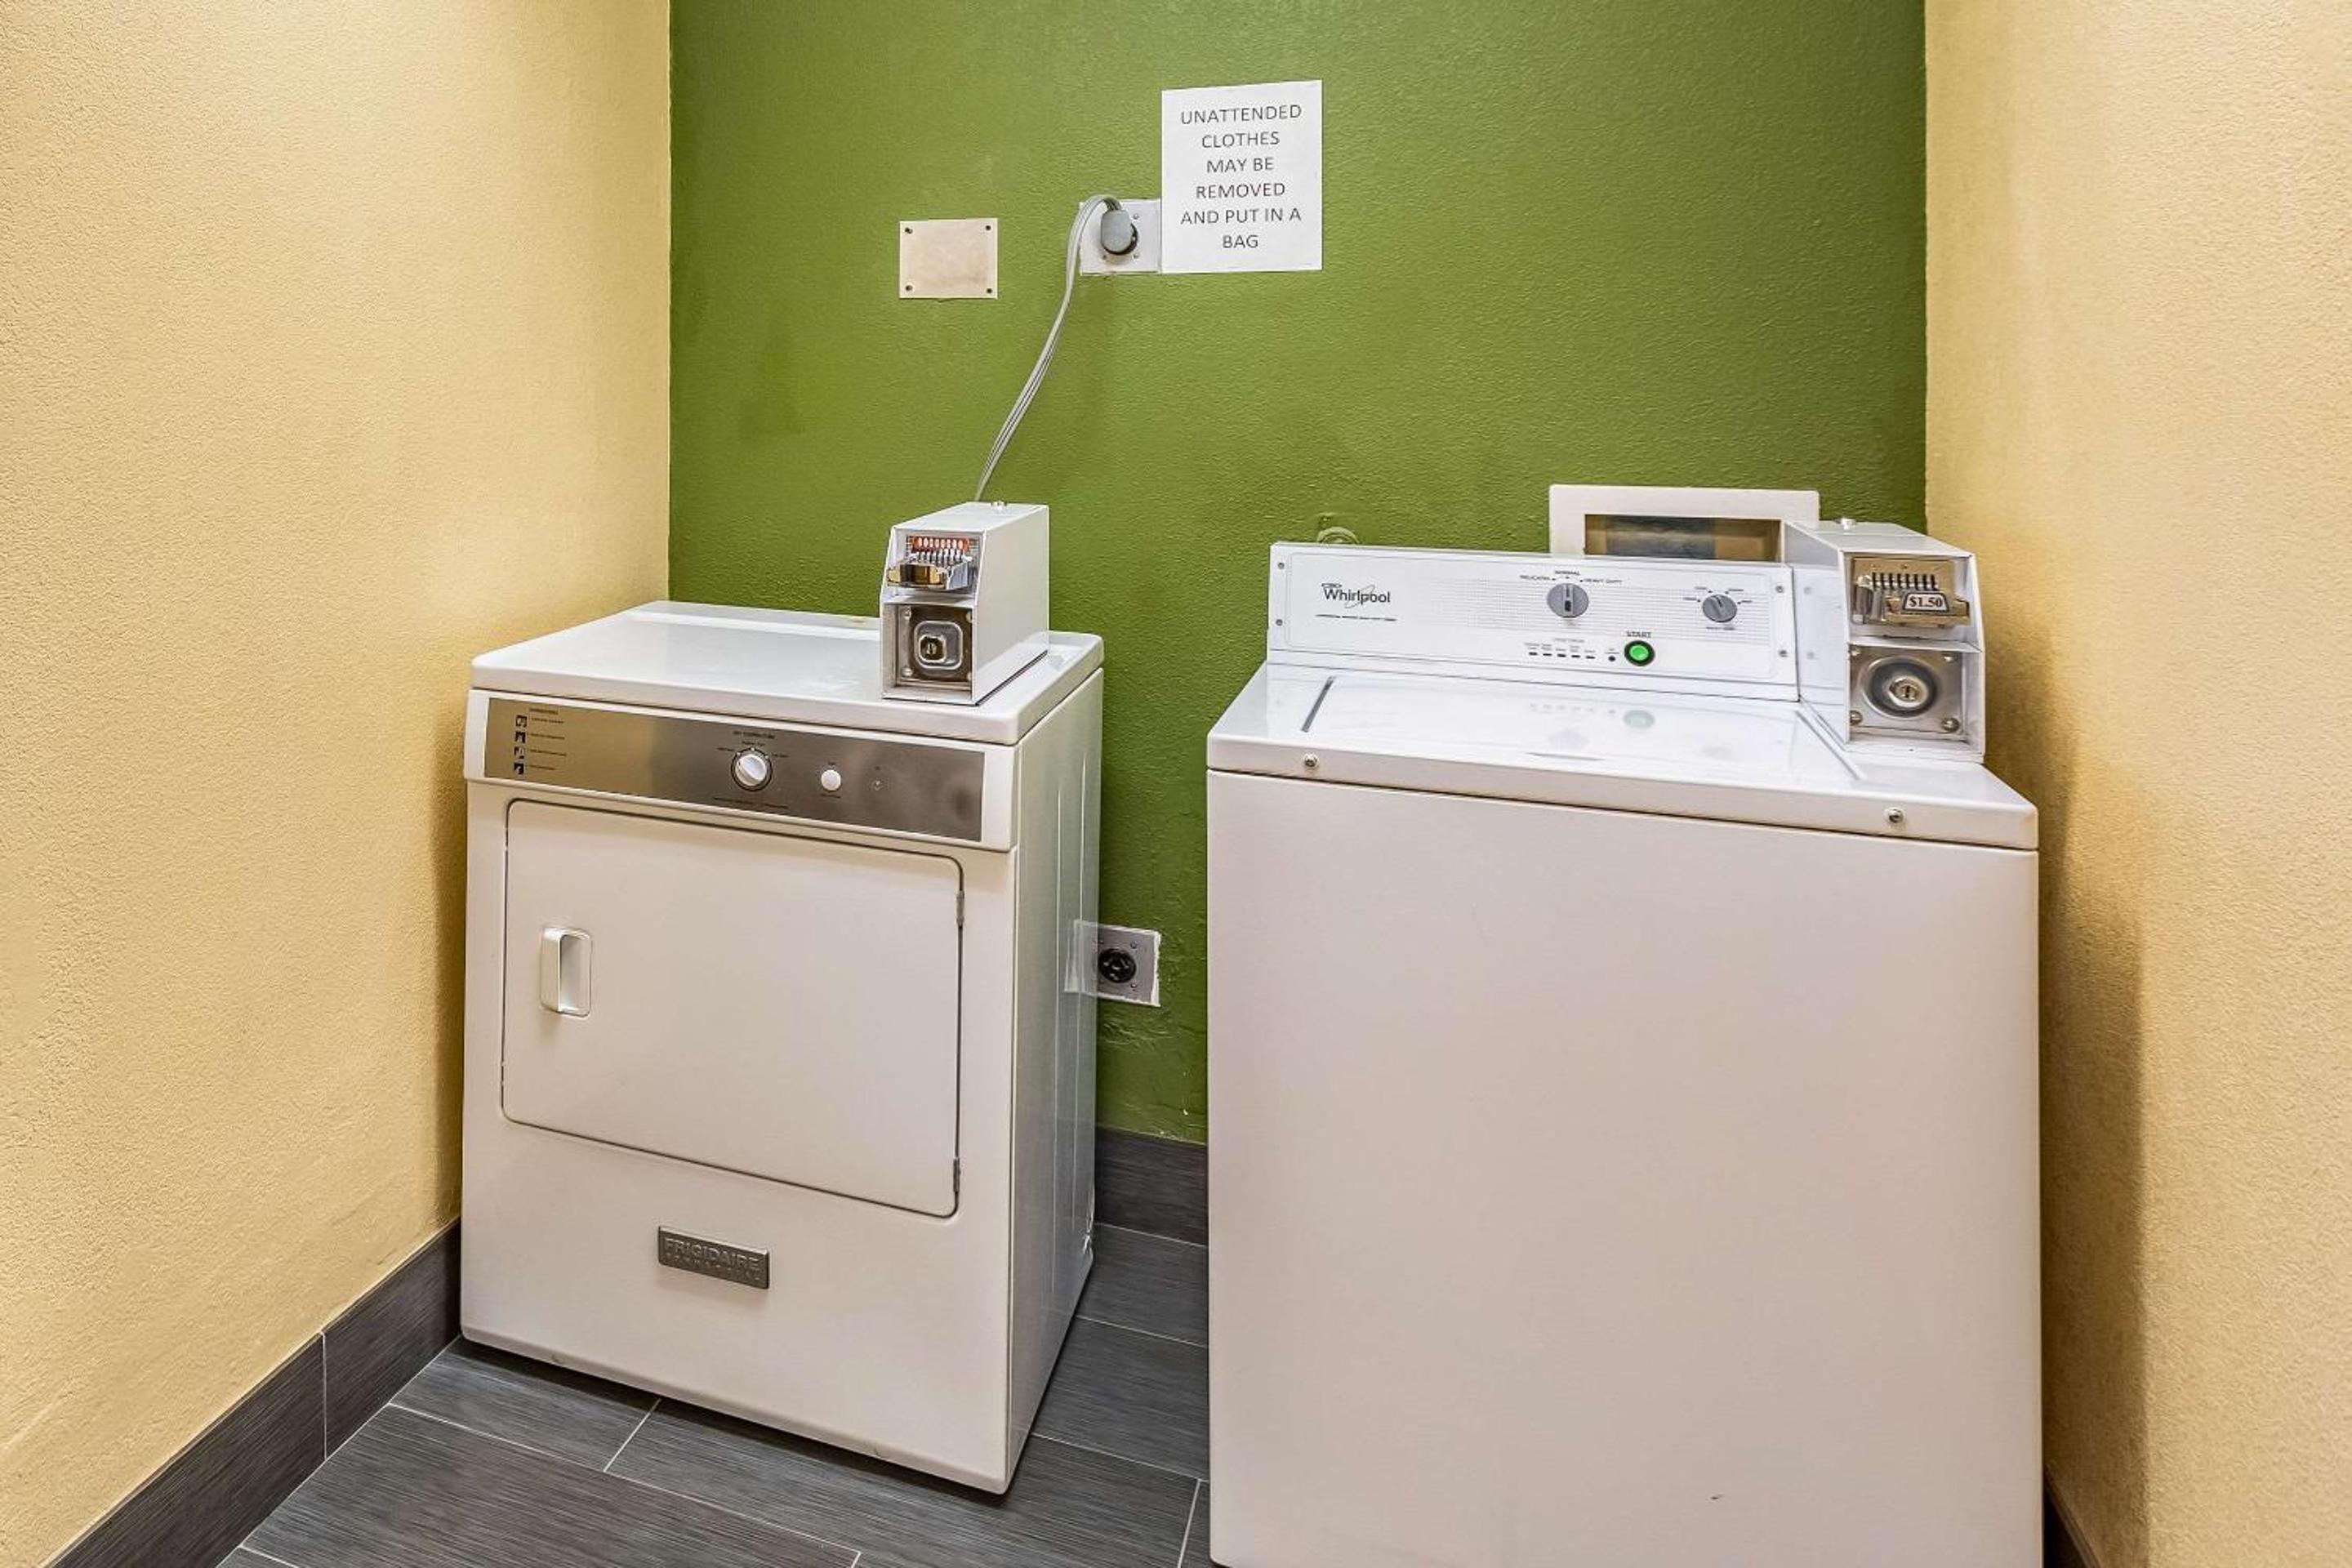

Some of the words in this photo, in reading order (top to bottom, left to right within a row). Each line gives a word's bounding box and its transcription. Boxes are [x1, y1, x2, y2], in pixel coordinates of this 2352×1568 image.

[1181, 104, 1302, 125] UNATTENDED
[1201, 131, 1281, 149] CLOTHES
[1206, 158, 1247, 174] MAY
[1253, 157, 1274, 172] BE
[1196, 182, 1285, 199] REMOVED
[1180, 210, 1219, 225] AND
[1225, 208, 1259, 224] PUT
[1265, 208, 1283, 222] IN
[1289, 207, 1302, 221] A
[1222, 234, 1259, 249] BAG
[1323, 588, 1391, 606] Whirlpool
[1909, 595, 1944, 608] $1.50
[663, 1236, 761, 1272] FRIGIDAIRE
